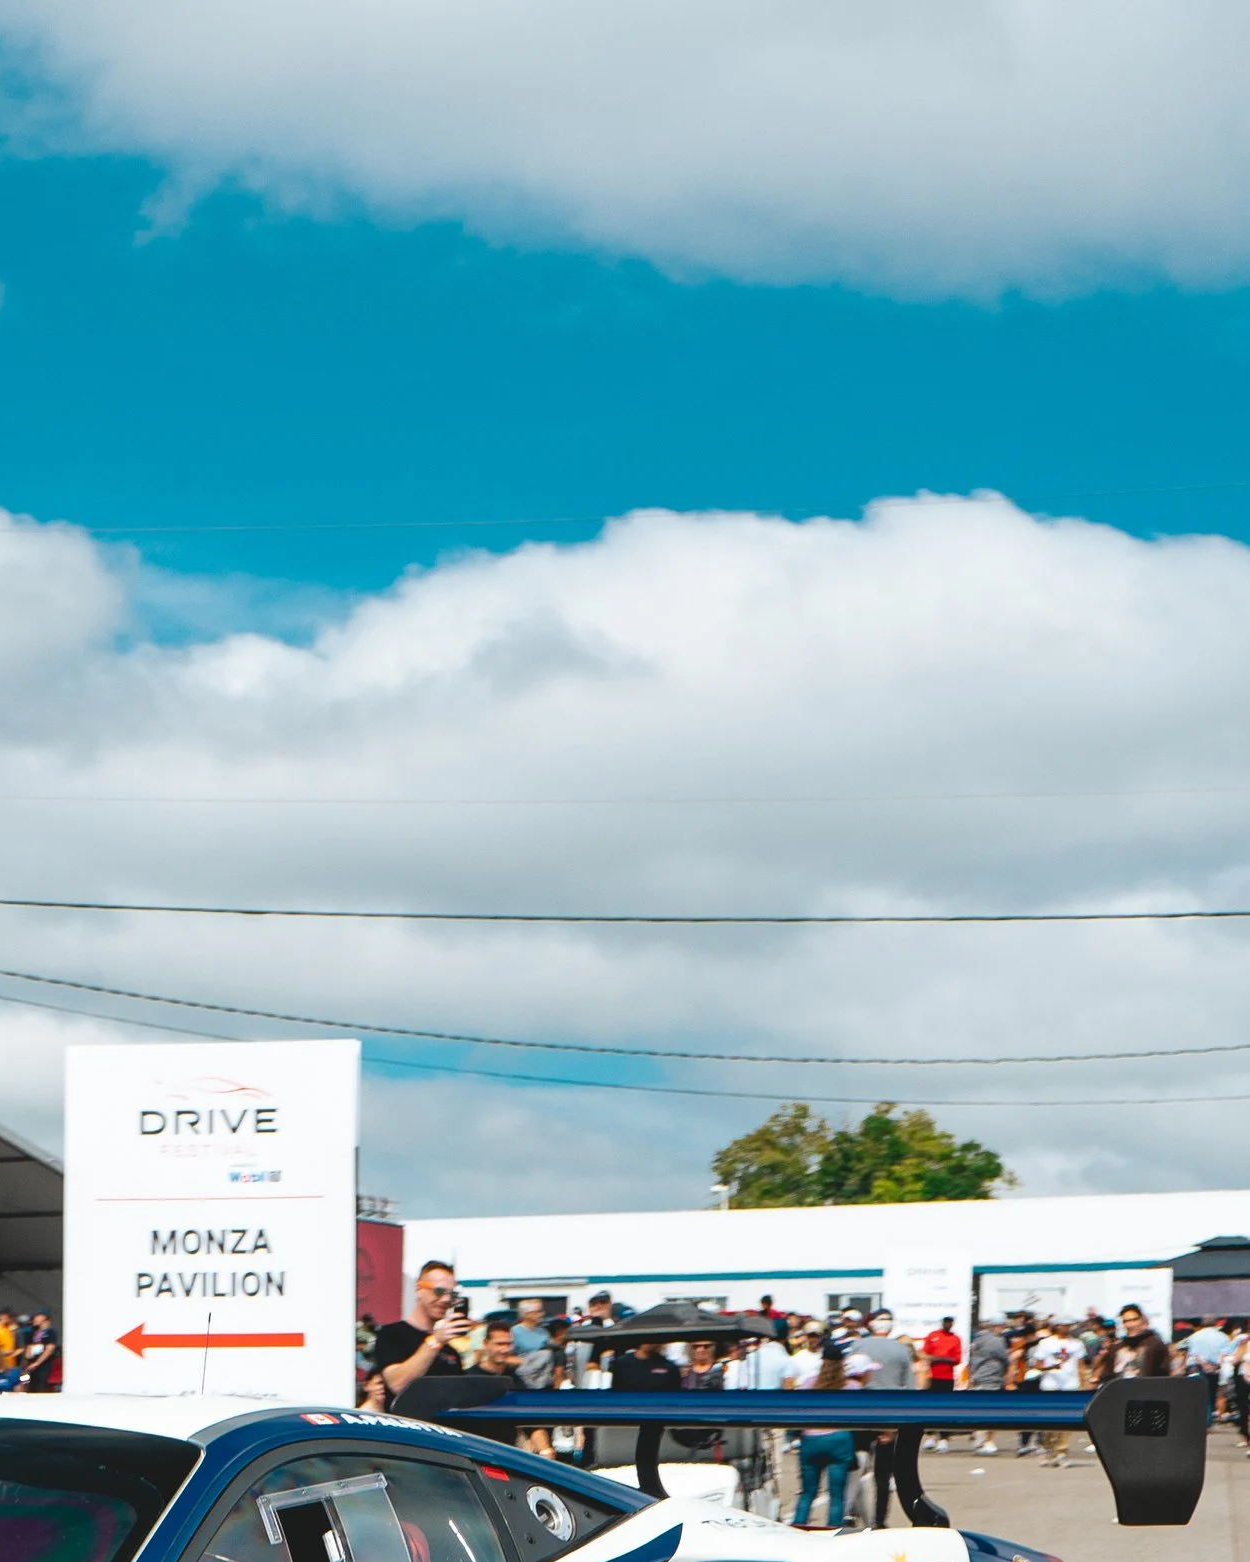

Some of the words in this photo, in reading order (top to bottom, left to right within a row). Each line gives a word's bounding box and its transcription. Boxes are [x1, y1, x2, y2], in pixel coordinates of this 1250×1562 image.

[140, 1108, 279, 1135] DRIVE
[150, 1229, 273, 1255] MONZA
[135, 1271, 286, 1298] PAVILION
